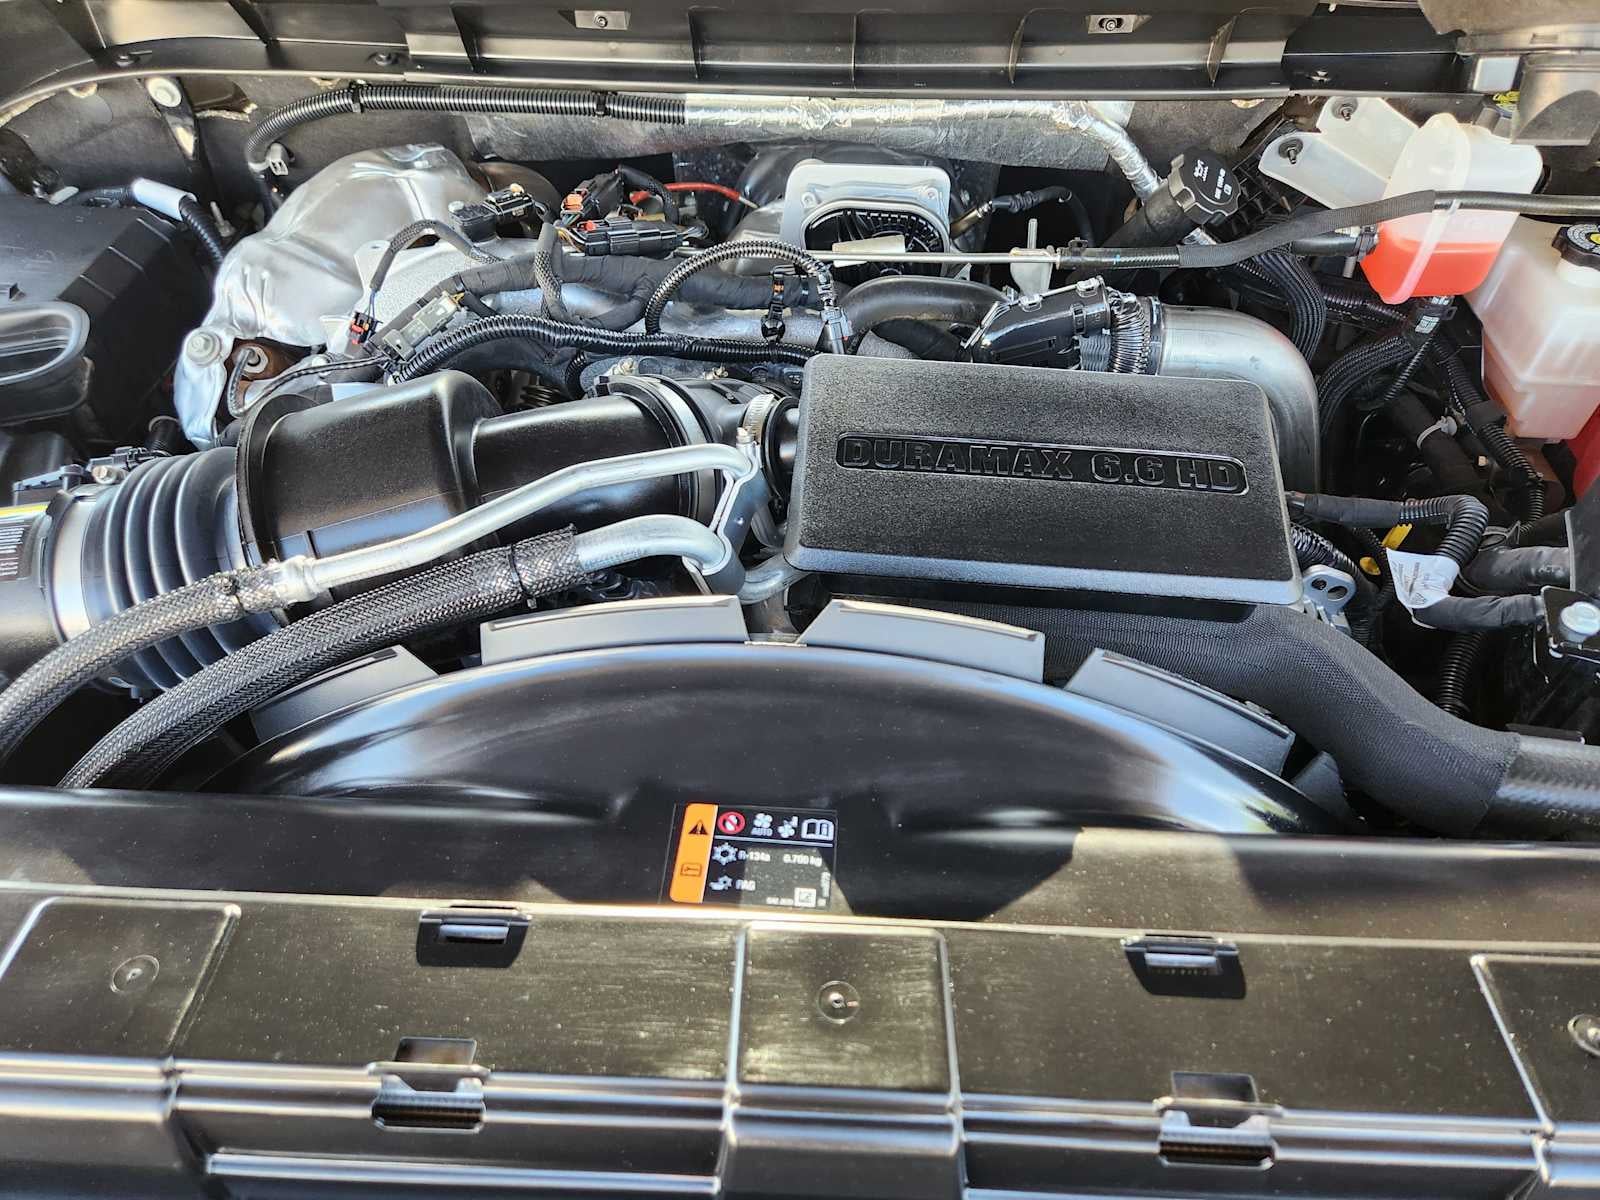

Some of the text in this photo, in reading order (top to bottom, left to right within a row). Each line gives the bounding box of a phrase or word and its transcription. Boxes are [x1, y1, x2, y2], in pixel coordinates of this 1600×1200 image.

[843, 438, 1239, 491] DURAMAX 6.6 HD
[751, 827, 773, 837] AUTO
